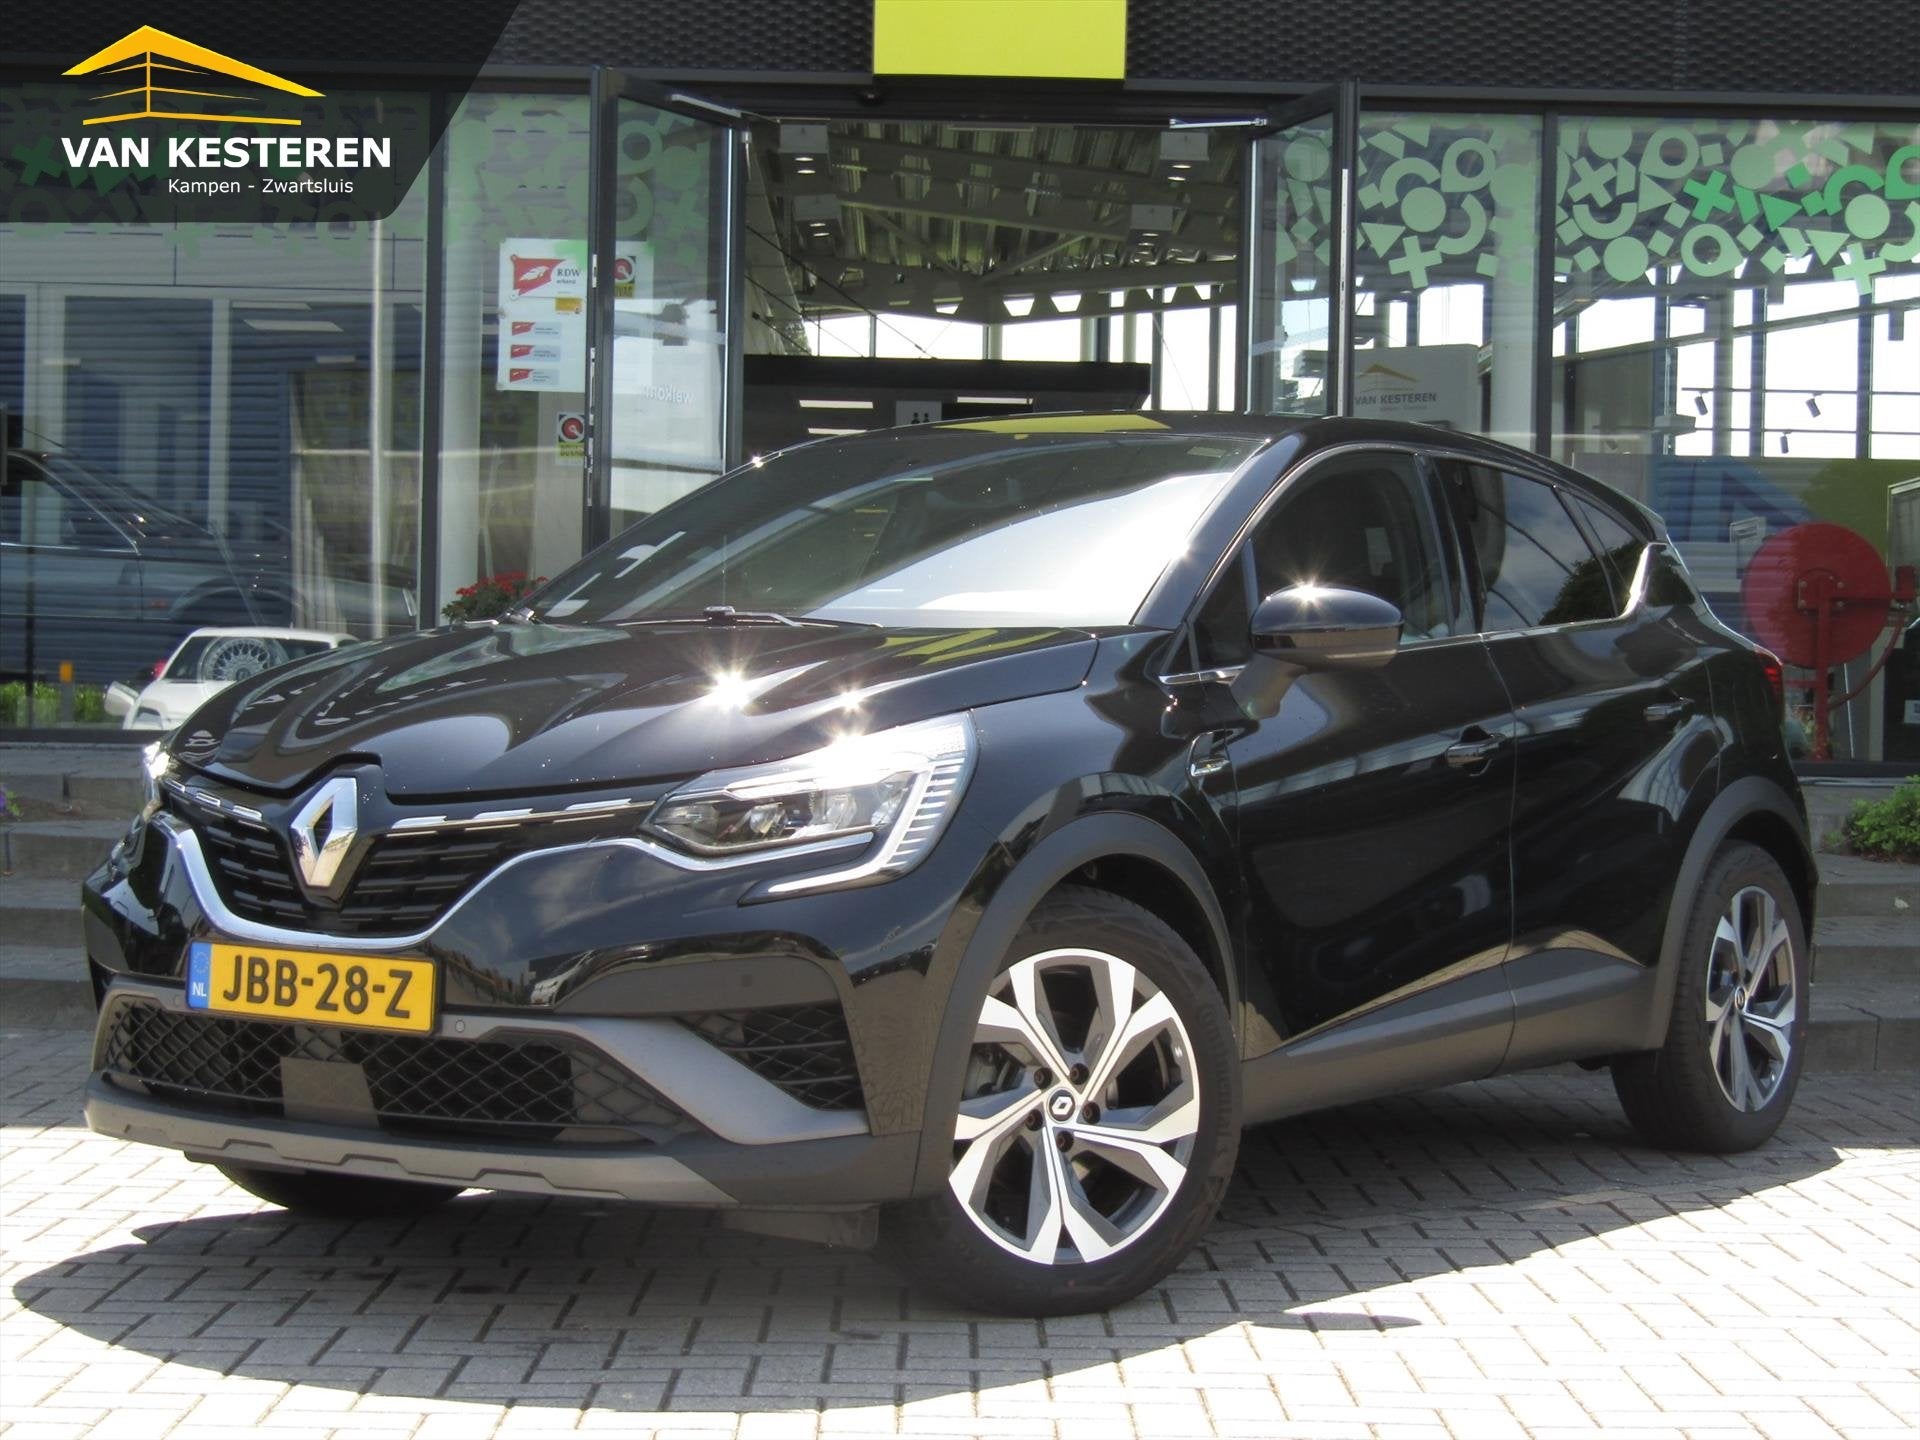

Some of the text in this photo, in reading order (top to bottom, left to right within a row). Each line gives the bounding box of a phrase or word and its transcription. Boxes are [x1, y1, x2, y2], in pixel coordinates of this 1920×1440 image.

[556, 268, 580, 277] RDW
[1355, 392, 1437, 405] VAN KESTEREN
[191, 982, 207, 998] NL
[223, 955, 413, 1019] JBB-28-Z
